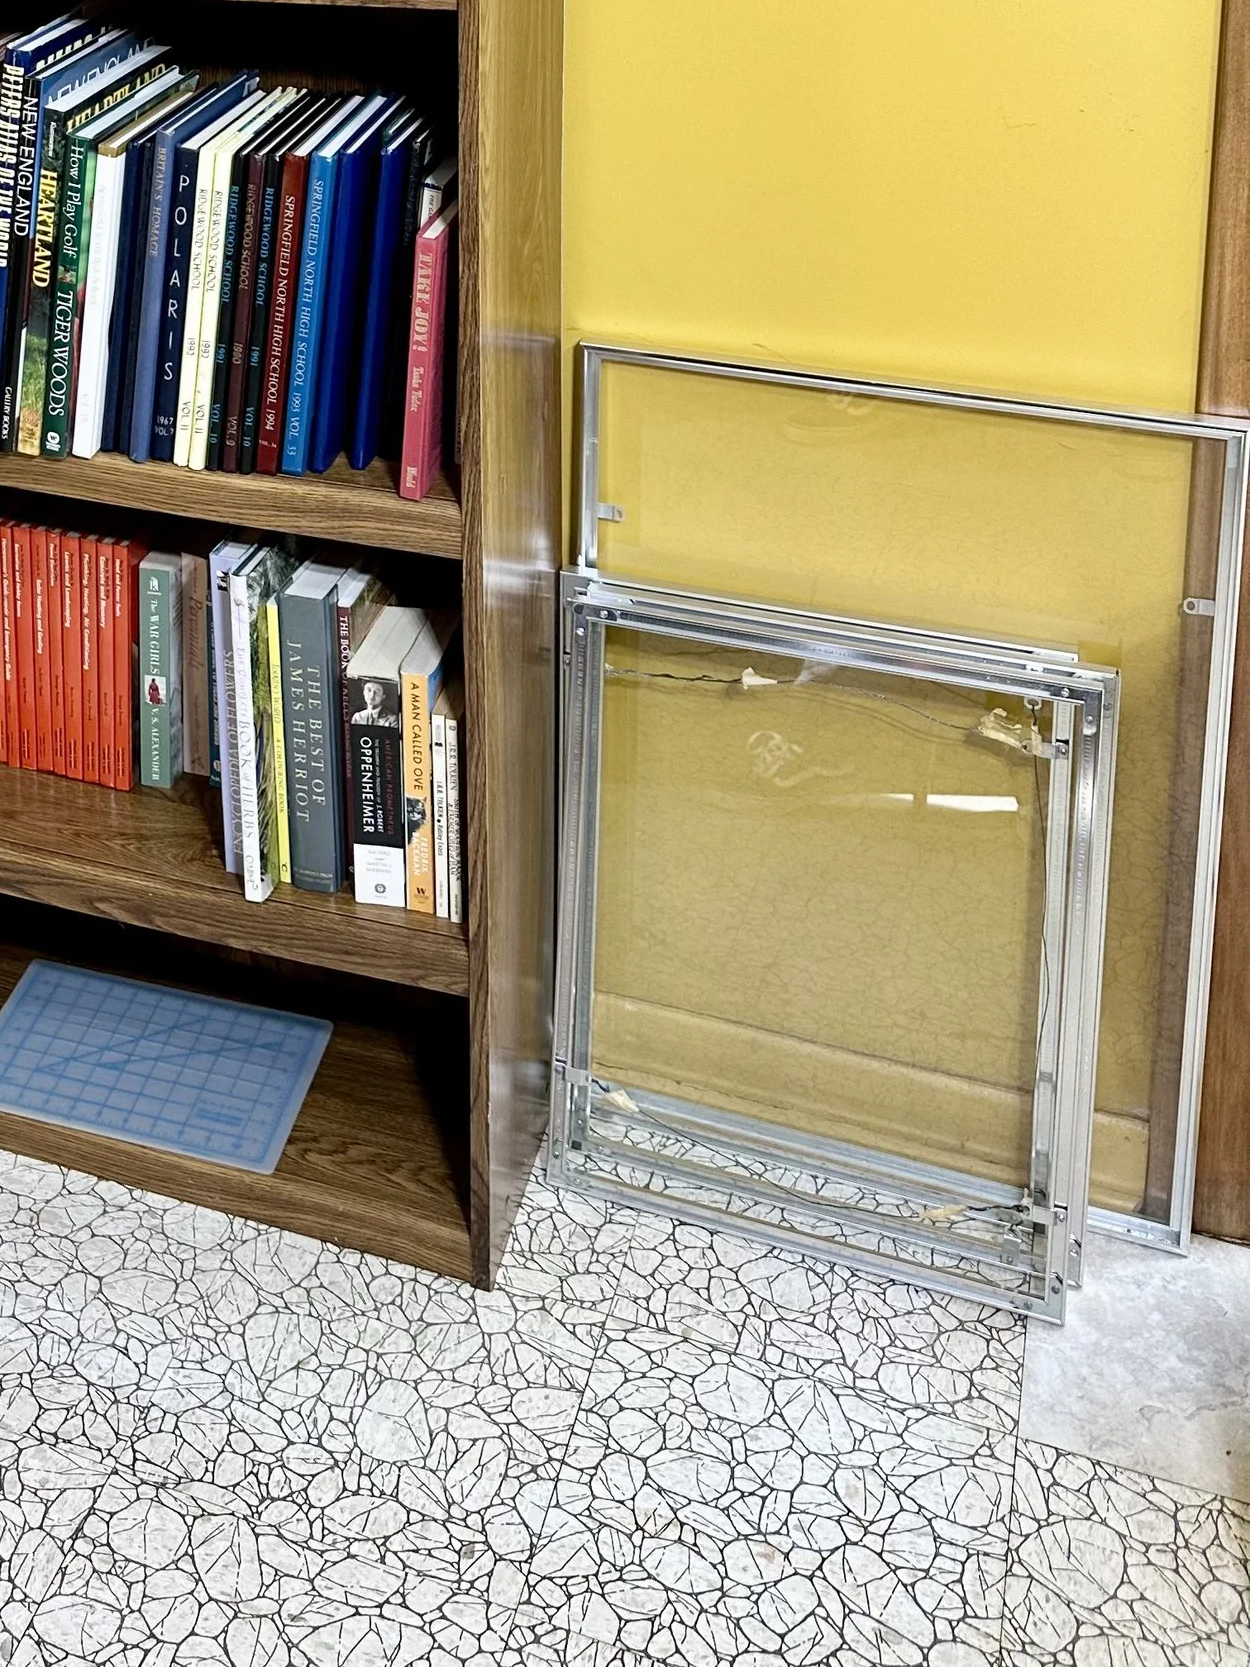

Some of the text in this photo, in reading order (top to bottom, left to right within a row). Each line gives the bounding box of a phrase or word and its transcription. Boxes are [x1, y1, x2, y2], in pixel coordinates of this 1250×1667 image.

[0, 63, 24, 118] PETERS
[14, 97, 37, 236] NEW ENGLAND
[69, 145, 84, 179] How
[32, 169, 57, 288] HEARTLAND
[64, 192, 80, 221] Play
[149, 147, 166, 258] BRITAIN'S HOMAGE
[260, 187, 275, 260] RIDGEWOOD
[307, 179, 324, 256] SPRINGFIELD
[63, 225, 78, 258] Golf
[163, 174, 190, 382] POLARIS
[255, 262, 269, 308] SCHOOL
[303, 260, 316, 302] NORTH
[415, 252, 433, 304] TAKE
[265, 194, 296, 431] SPRINGFIELD NORTH HIGH SCHOOL 1994
[299, 306, 311, 336] HIGH
[413, 306, 431, 352] JOY!
[49, 289, 73, 417] TIGER WOODS
[250, 346, 260, 366] 1991
[294, 340, 308, 386] SCHOOL
[291, 392, 302, 412] 1993
[242, 436, 252, 447] 10
[288, 445, 296, 455] 33
[149, 599, 161, 675] The WAR GIRLS
[188, 597, 204, 670] Perennials
[339, 616, 349, 638] THE
[340, 640, 350, 669] BOOK
[151, 726, 162, 780] ALEXANDER
[223, 650, 244, 854] ENCYCLOPEDIA OF FLOWERS
[286, 639, 309, 822] JAMES HERRIOT
[306, 666, 326, 806] THE BEST OF
[410, 683, 424, 791] A MAN CALLED OVE
[359, 737, 374, 833] OPPENHEIMER
